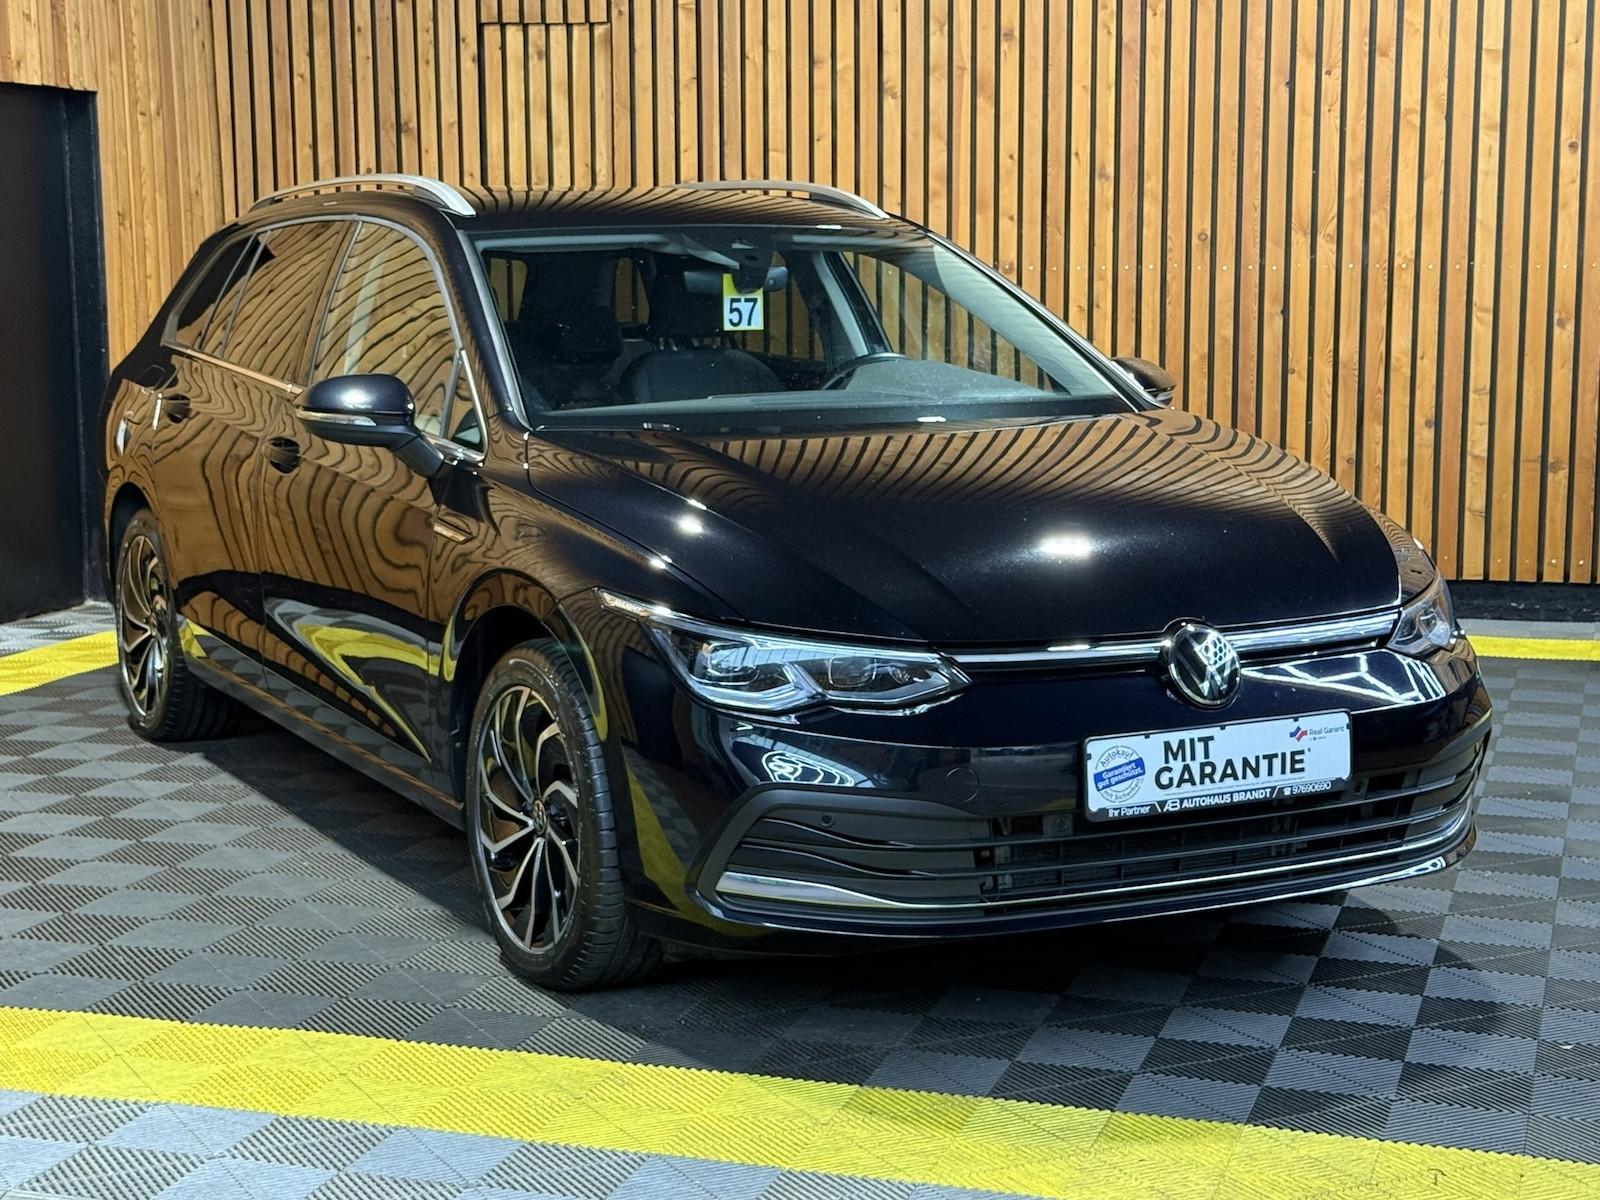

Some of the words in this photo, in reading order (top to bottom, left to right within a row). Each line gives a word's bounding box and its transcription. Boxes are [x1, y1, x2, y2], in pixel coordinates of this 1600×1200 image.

[728, 297, 759, 328] 57
[1163, 735, 1215, 765] MIT
[1154, 749, 1306, 791] GARANTIE
[1108, 807, 1121, 818] Ihr
[1120, 804, 1151, 817] Partner
[1181, 793, 1232, 809] AUTOHAUS
[1232, 787, 1272, 803] BRANDT
